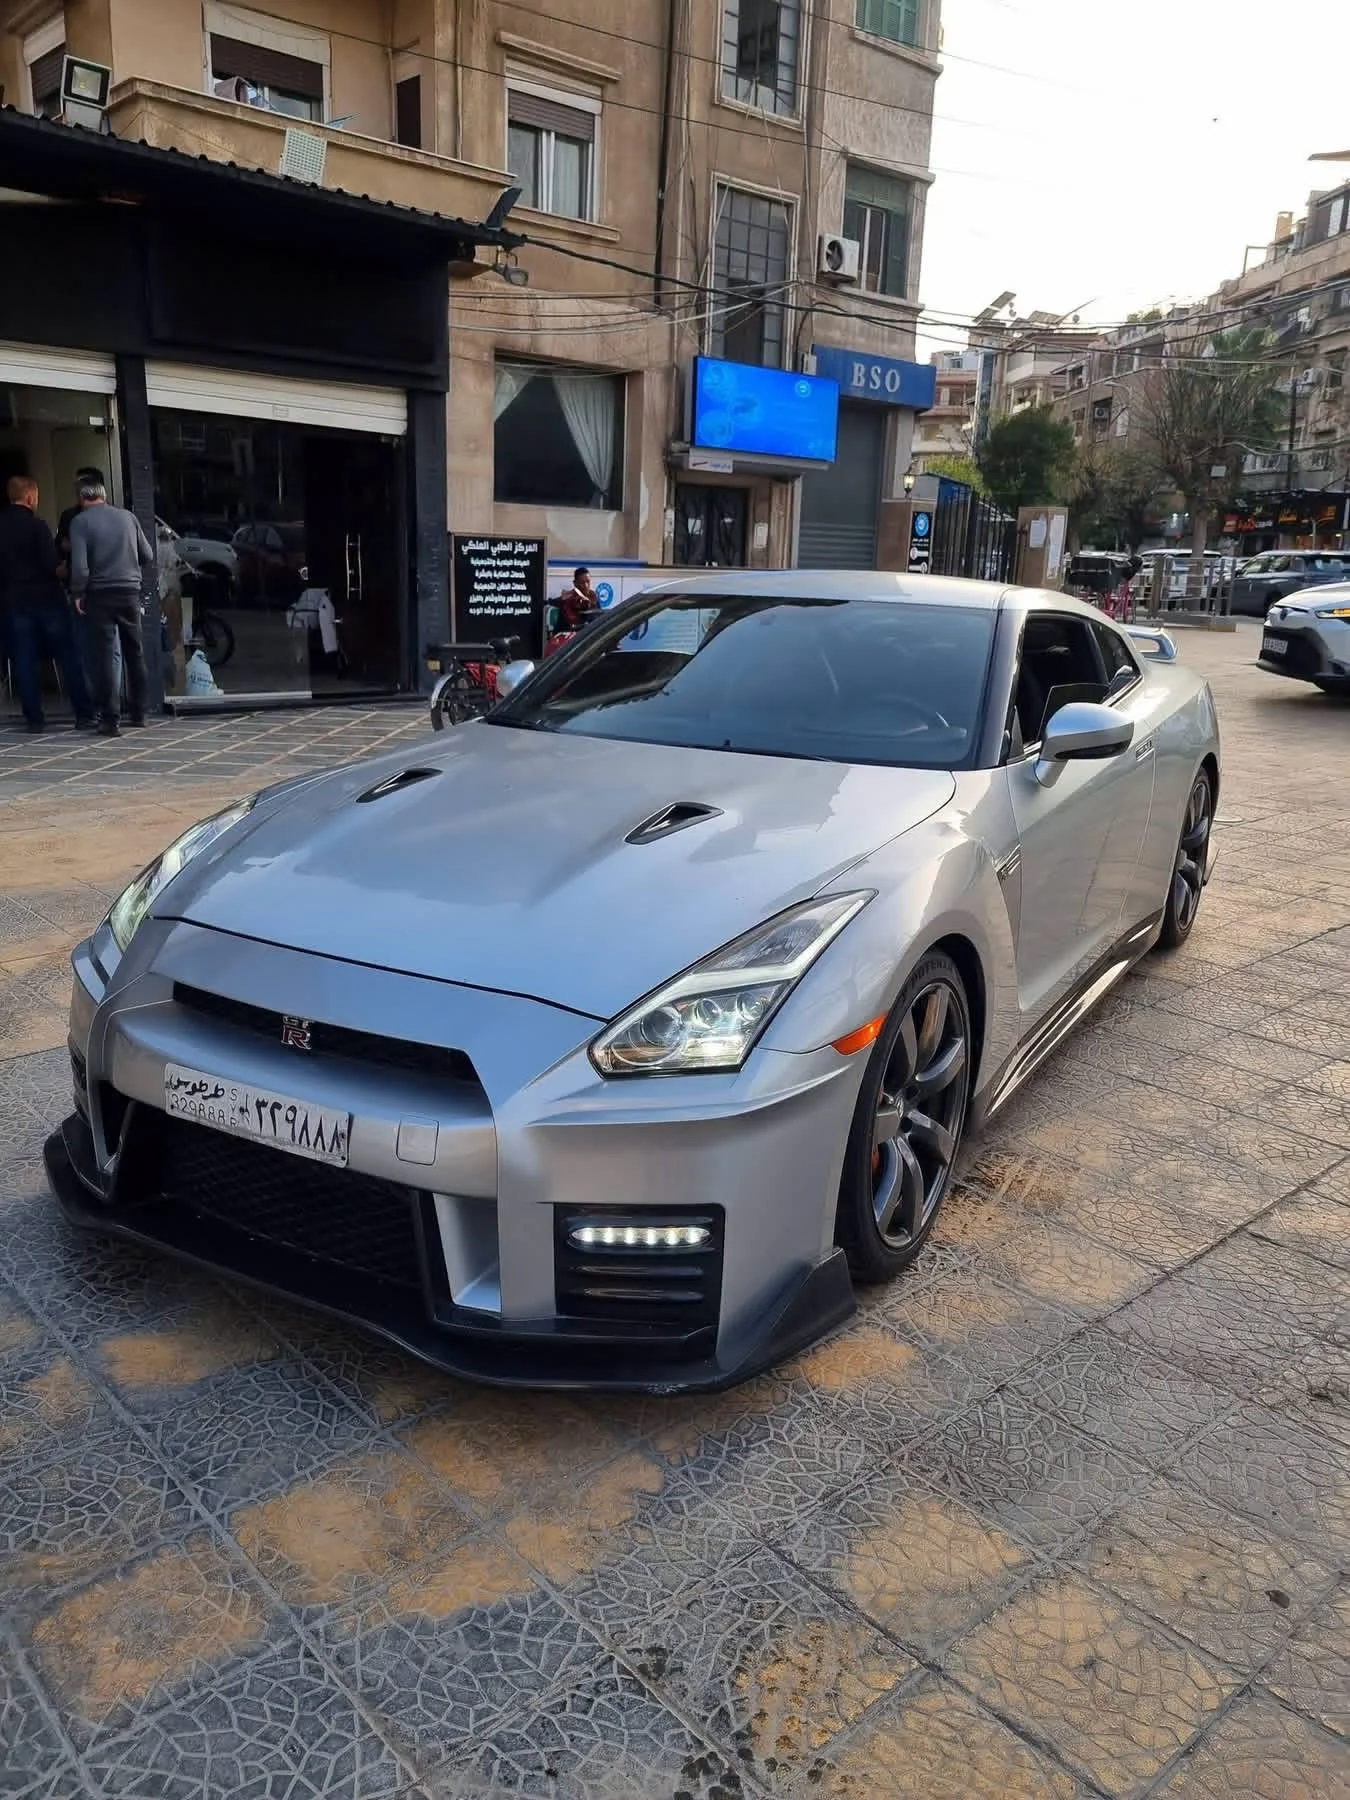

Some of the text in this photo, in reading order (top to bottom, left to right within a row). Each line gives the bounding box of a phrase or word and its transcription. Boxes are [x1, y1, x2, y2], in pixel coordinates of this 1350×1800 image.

[851, 362, 901, 393] BSO
[461, 540, 538, 556] المركز الطبي الملكي
[510, 570, 526, 579] خدمات
[511, 582, 527, 591] خدمات
[169, 1074, 225, 1100] طرطوس
[171, 1093, 226, 1126] 329888
[255, 1096, 342, 1153] ٣٢٩٨٨٨
